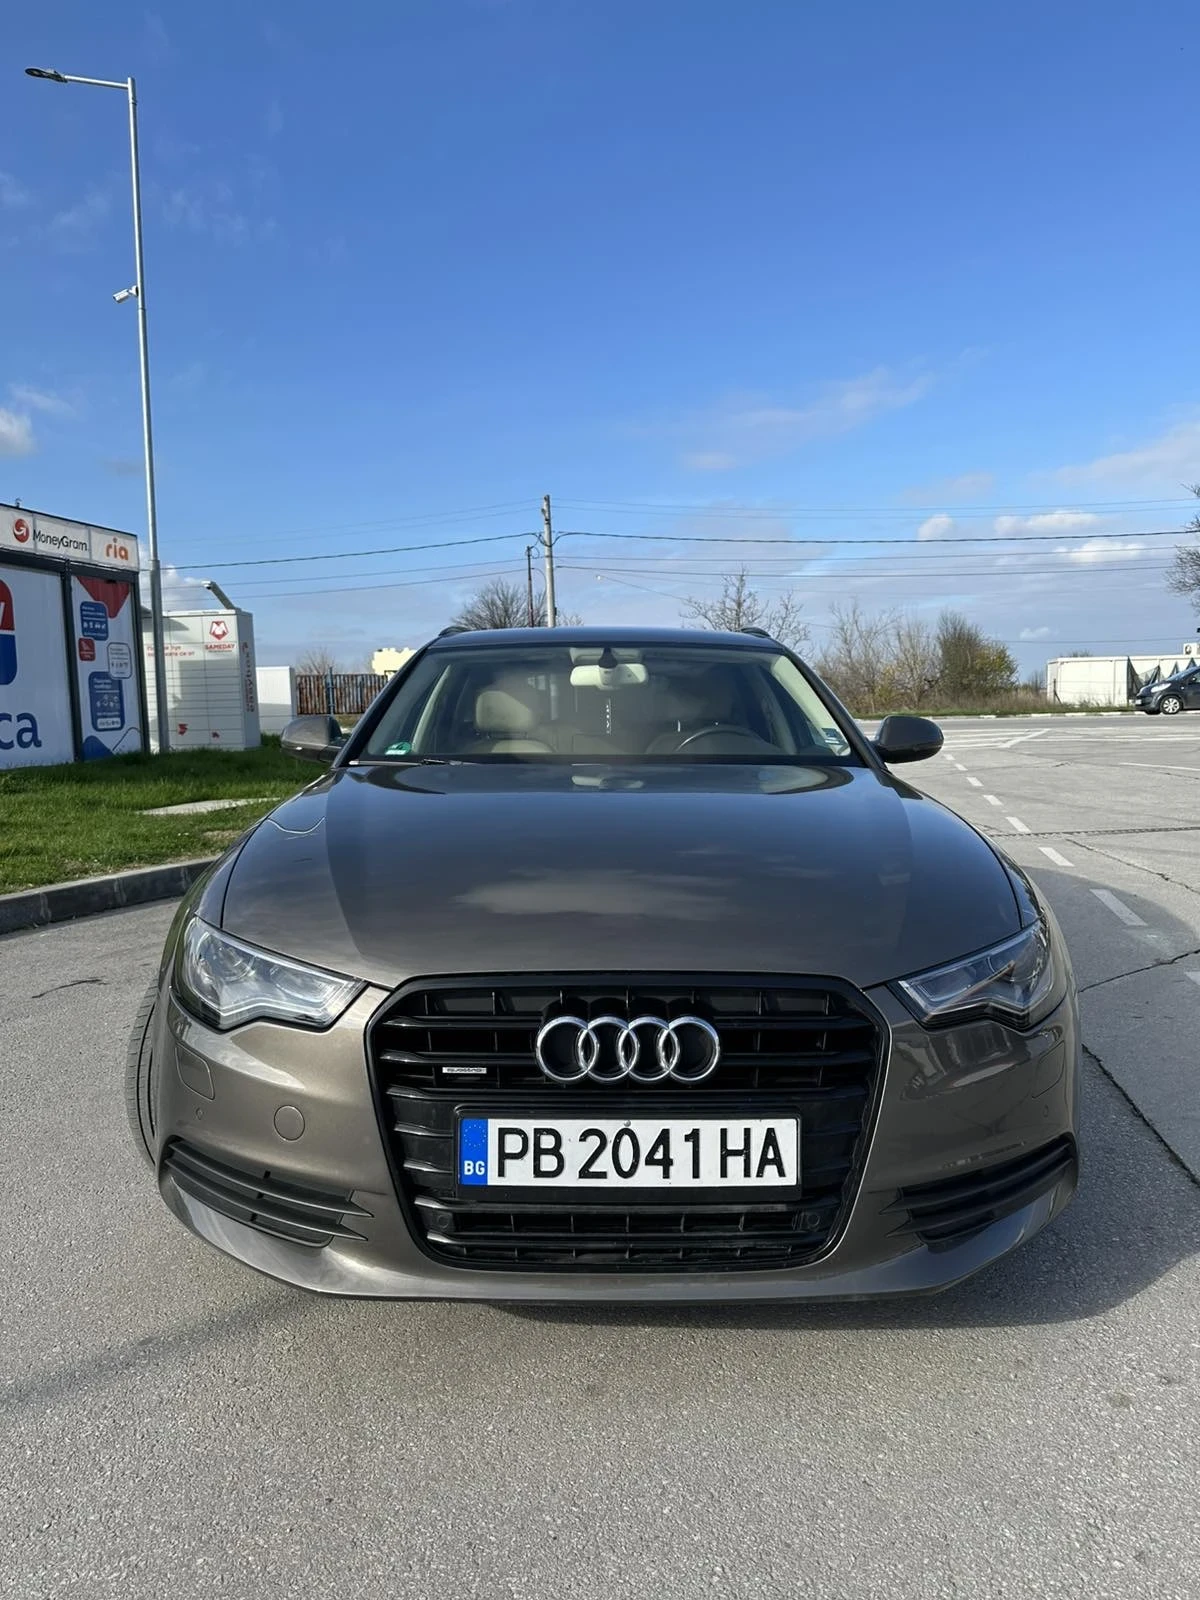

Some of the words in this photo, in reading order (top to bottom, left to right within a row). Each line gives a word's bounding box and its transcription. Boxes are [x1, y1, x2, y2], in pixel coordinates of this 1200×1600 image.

[32, 529, 88, 551] MoneyGram
[105, 537, 129, 561] ria
[497, 1127, 565, 1179] PB
[577, 1127, 701, 1180] 2041
[719, 1127, 787, 1179] HA
[464, 1160, 485, 1175] BG
